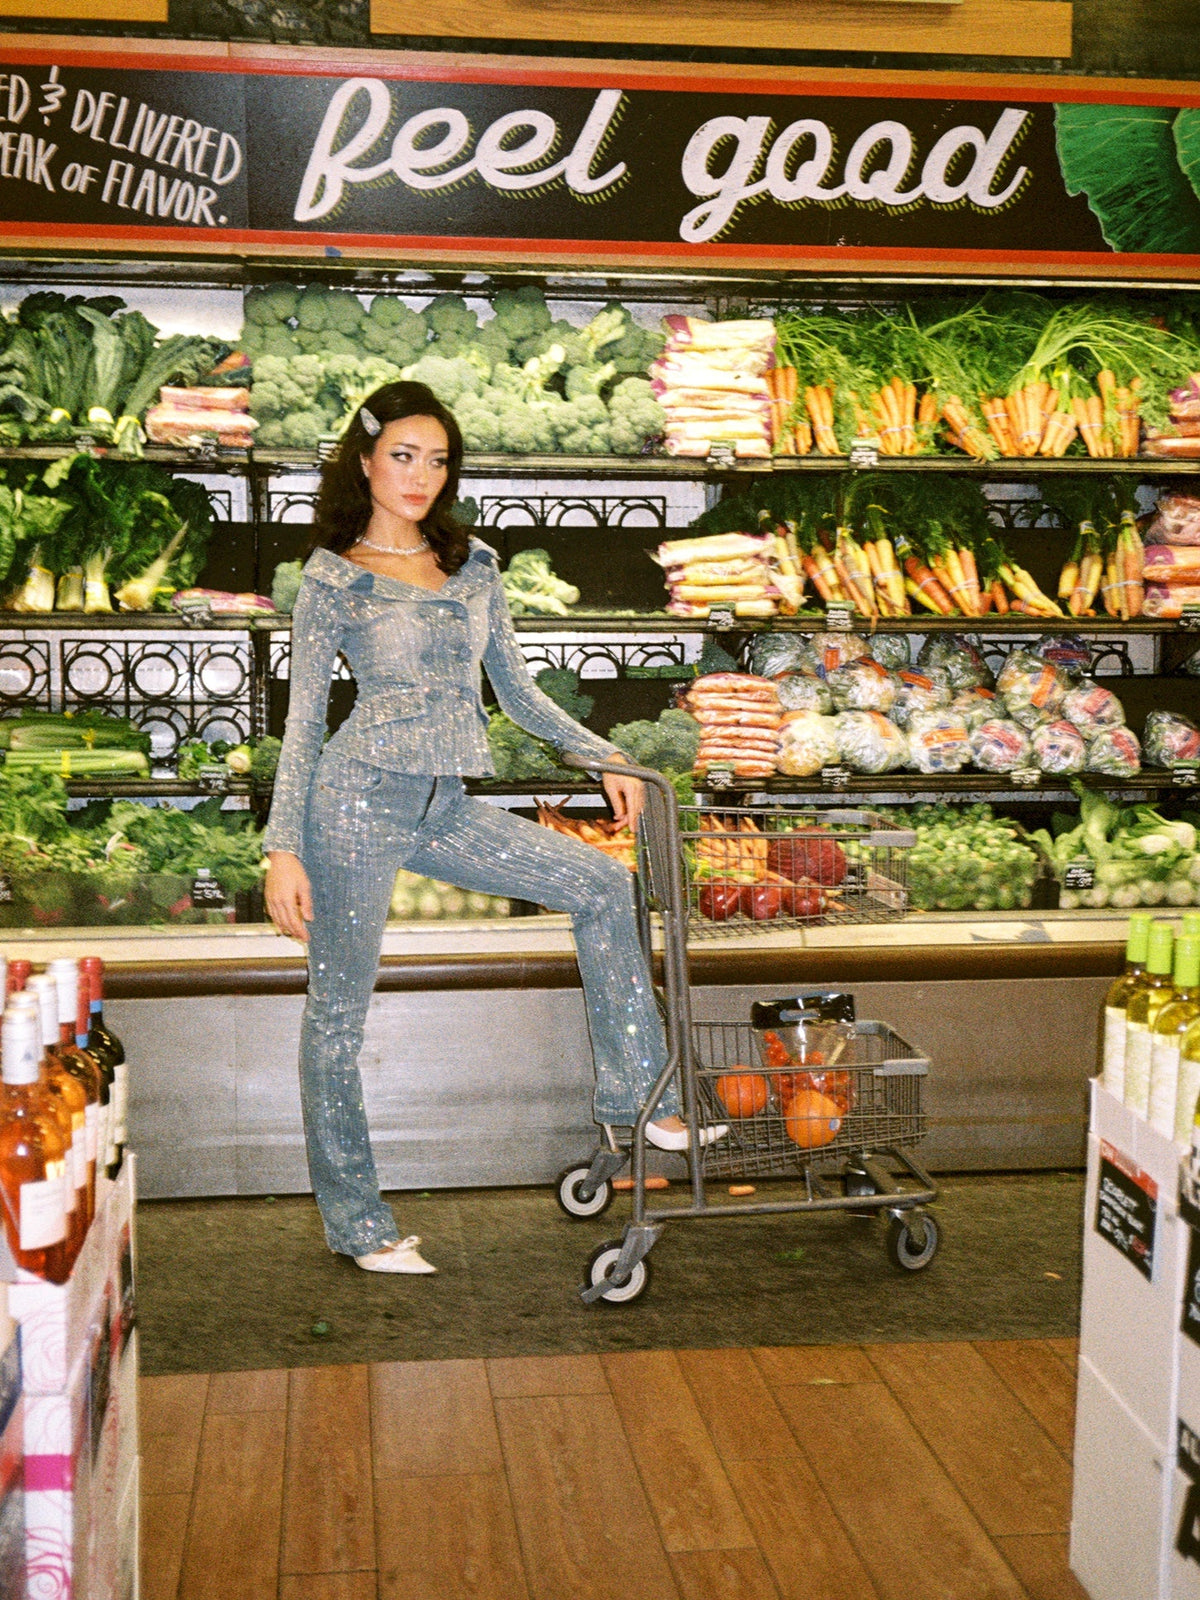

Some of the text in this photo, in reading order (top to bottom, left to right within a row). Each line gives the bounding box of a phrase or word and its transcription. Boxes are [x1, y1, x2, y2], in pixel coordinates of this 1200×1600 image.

[38, 65, 66, 126] &
[70, 89, 243, 185] DELIVERED
[294, 77, 1027, 243] feel good
[61, 163, 100, 194] OF
[101, 159, 229, 226] FLAVOR.
